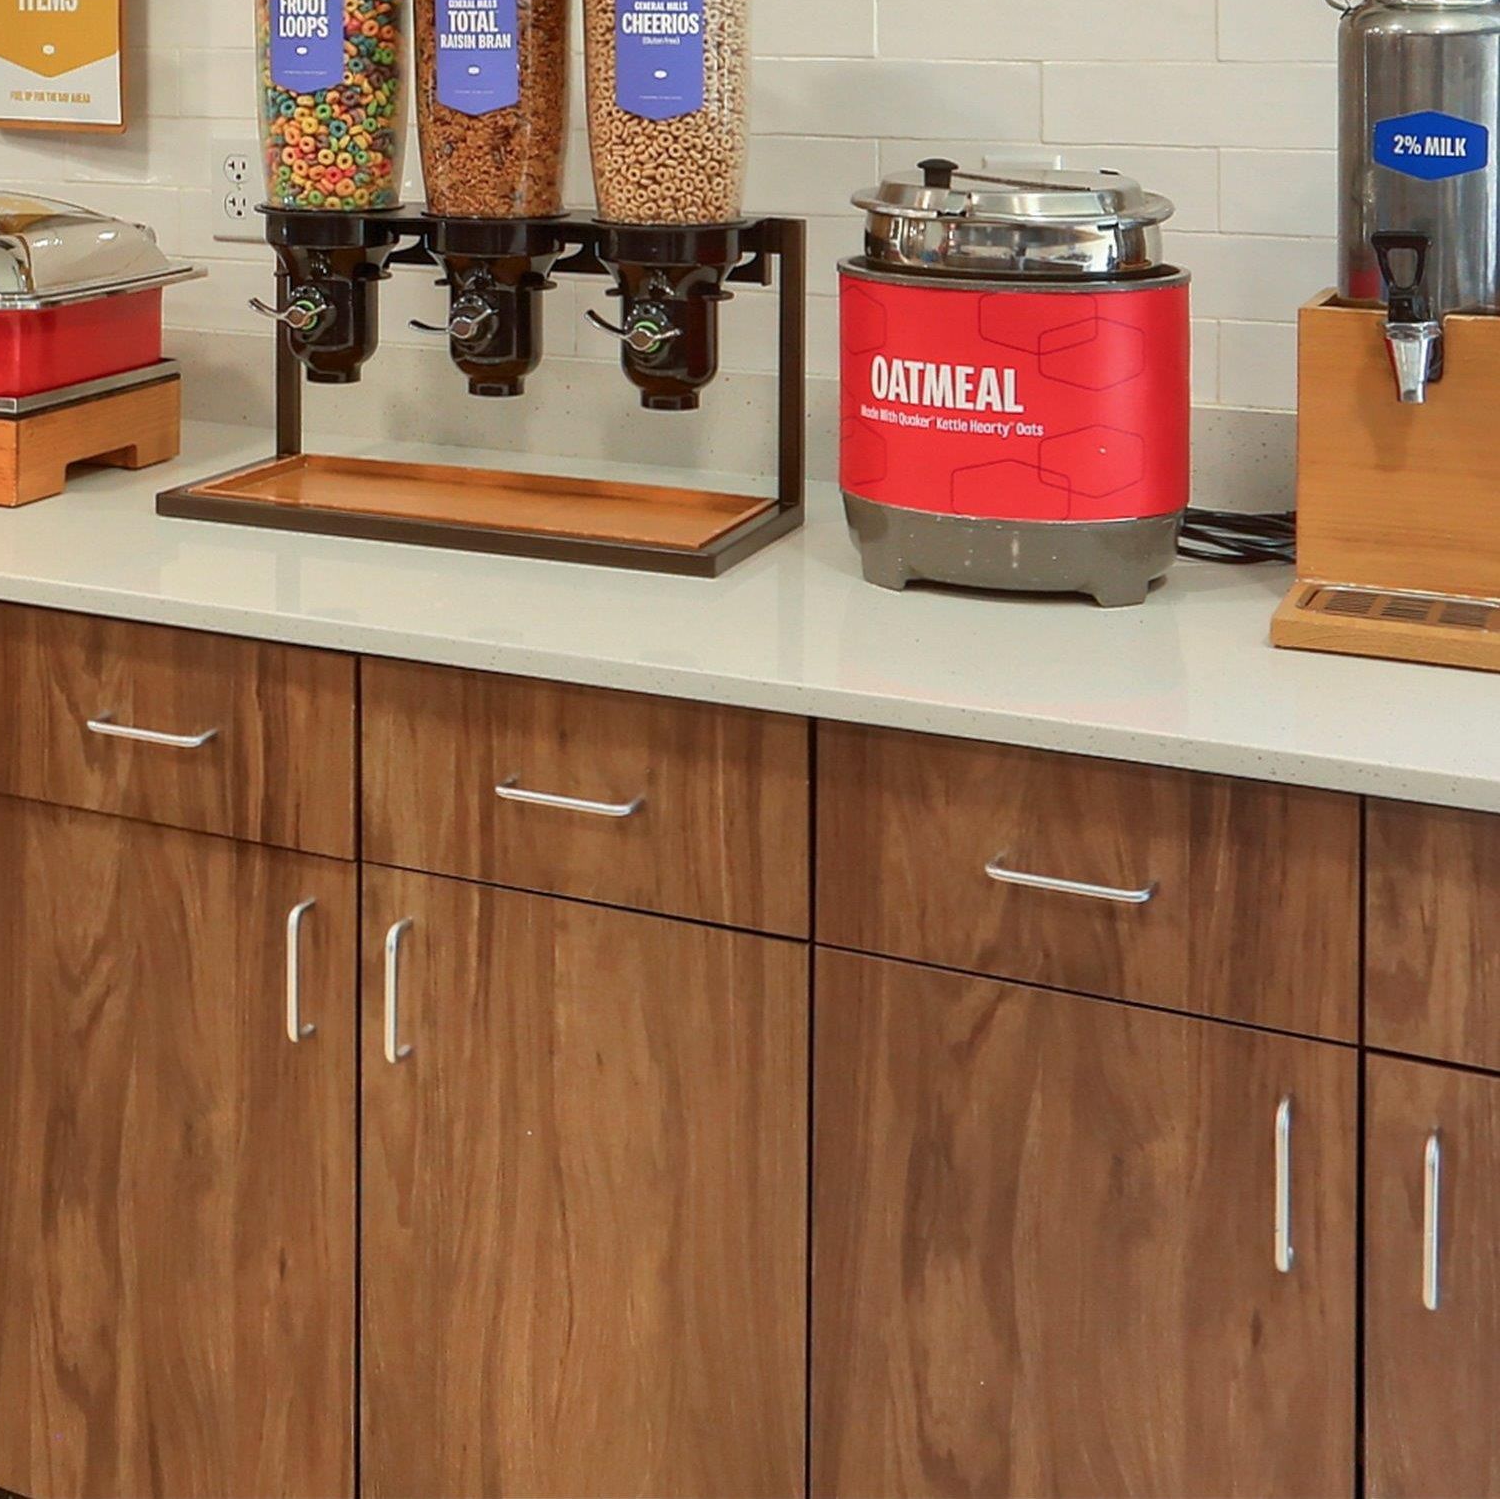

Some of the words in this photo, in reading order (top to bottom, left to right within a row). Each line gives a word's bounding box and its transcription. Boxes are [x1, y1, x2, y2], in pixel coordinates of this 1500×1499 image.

[279, 15, 329, 38] LOOPS
[448, 10, 499, 32] TOTAL
[622, 12, 700, 34] CHEERIOS
[440, 34, 476, 49] RAISIN
[478, 34, 511, 49] BRAN
[1393, 134, 1422, 155] 2%
[1424, 136, 1467, 157] MILK
[870, 354, 1025, 414] OATMEAL
[936, 416, 968, 433] Kettle
[1016, 422, 1044, 437] Oats
